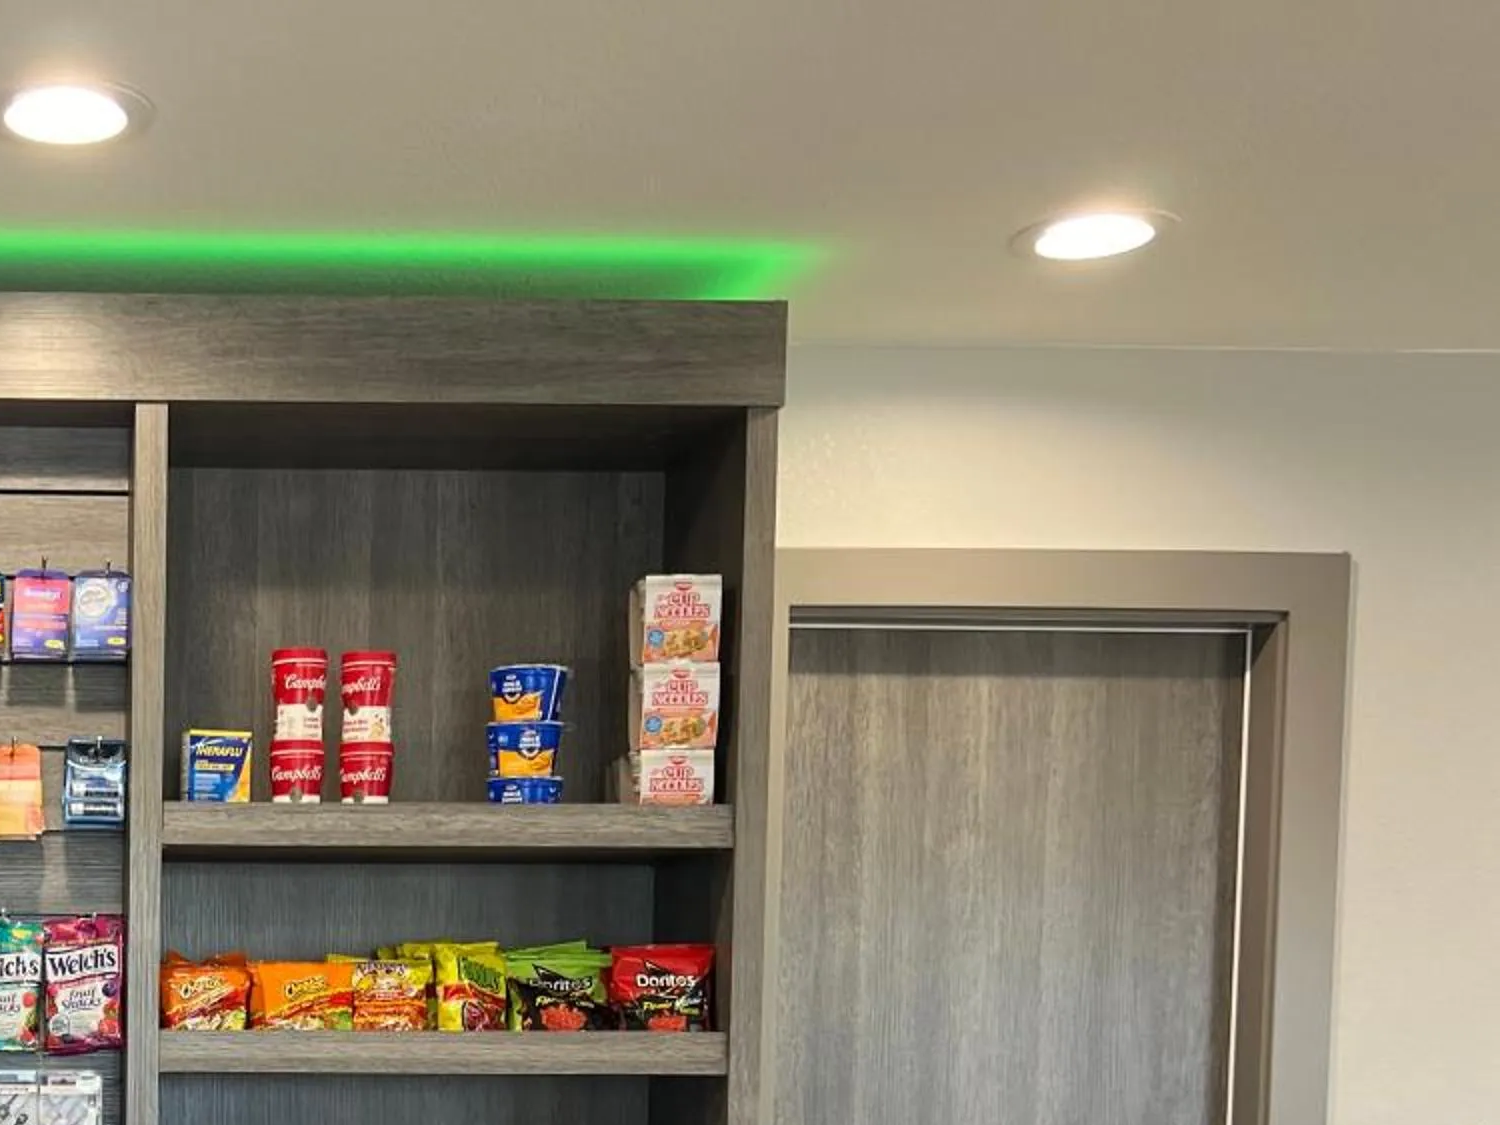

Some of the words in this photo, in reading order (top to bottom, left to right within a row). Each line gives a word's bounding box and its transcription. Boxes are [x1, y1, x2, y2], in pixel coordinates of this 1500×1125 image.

[271, 765, 322, 783] Campbell's
[50, 948, 117, 977] Welch's
[529, 975, 594, 992] Doritos
[636, 973, 697, 989] Doritos
